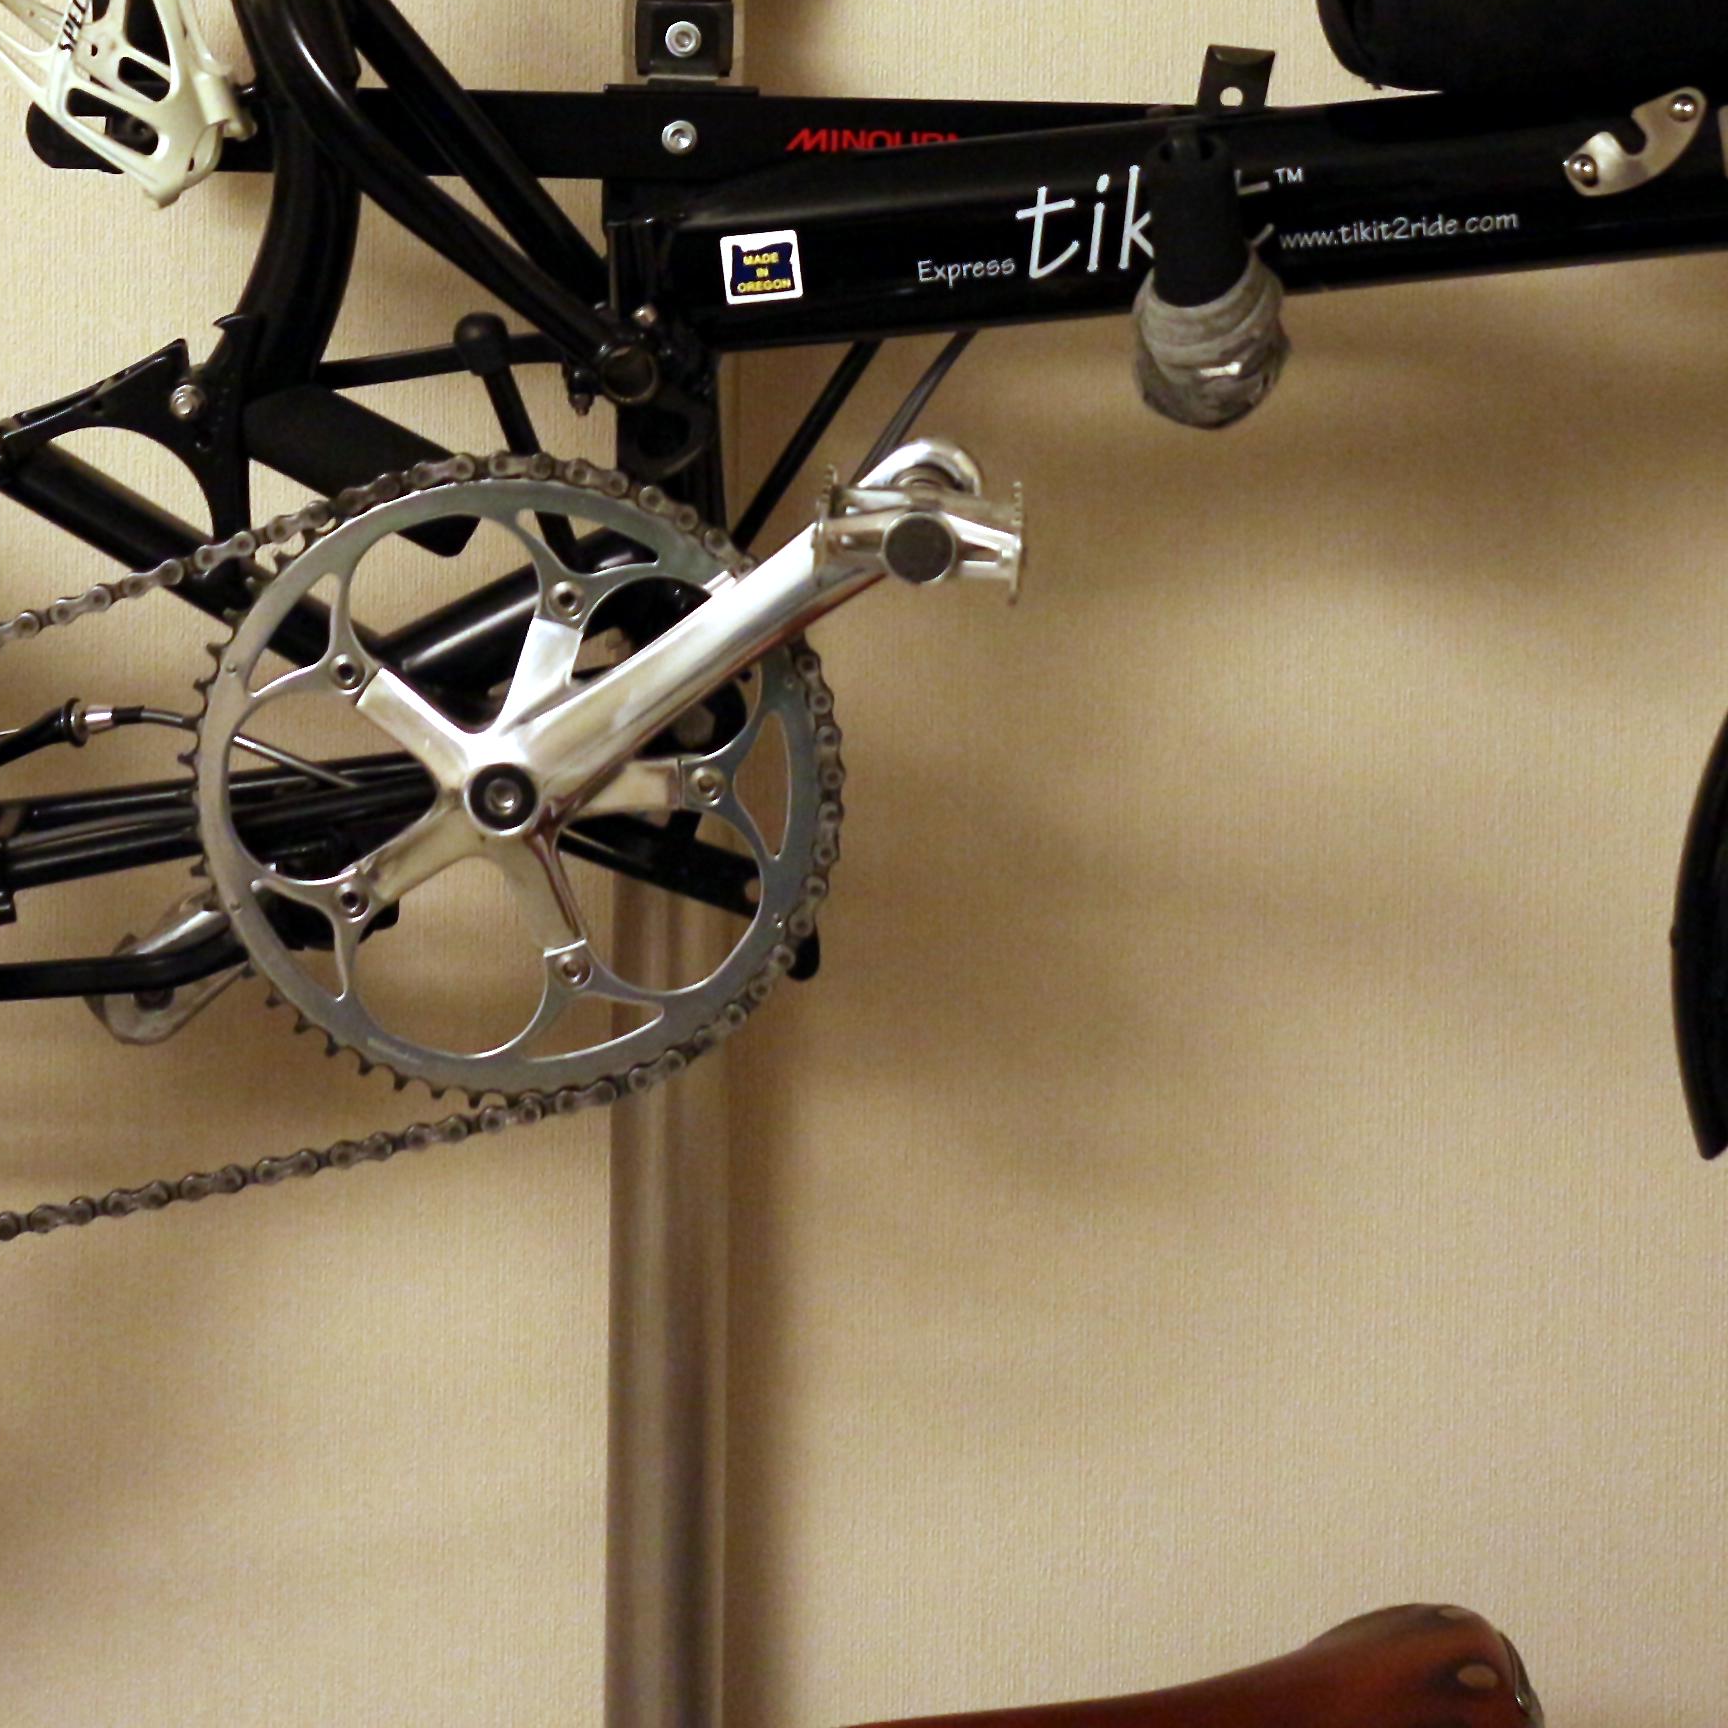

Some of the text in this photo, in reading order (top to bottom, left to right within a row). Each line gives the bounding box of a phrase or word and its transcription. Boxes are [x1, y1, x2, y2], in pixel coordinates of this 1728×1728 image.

[1279, 212, 1519, 250] www.tikit2ride.com
[743, 252, 779, 266] MADE
[917, 257, 1016, 286] Express
[737, 278, 792, 293] OREGON
